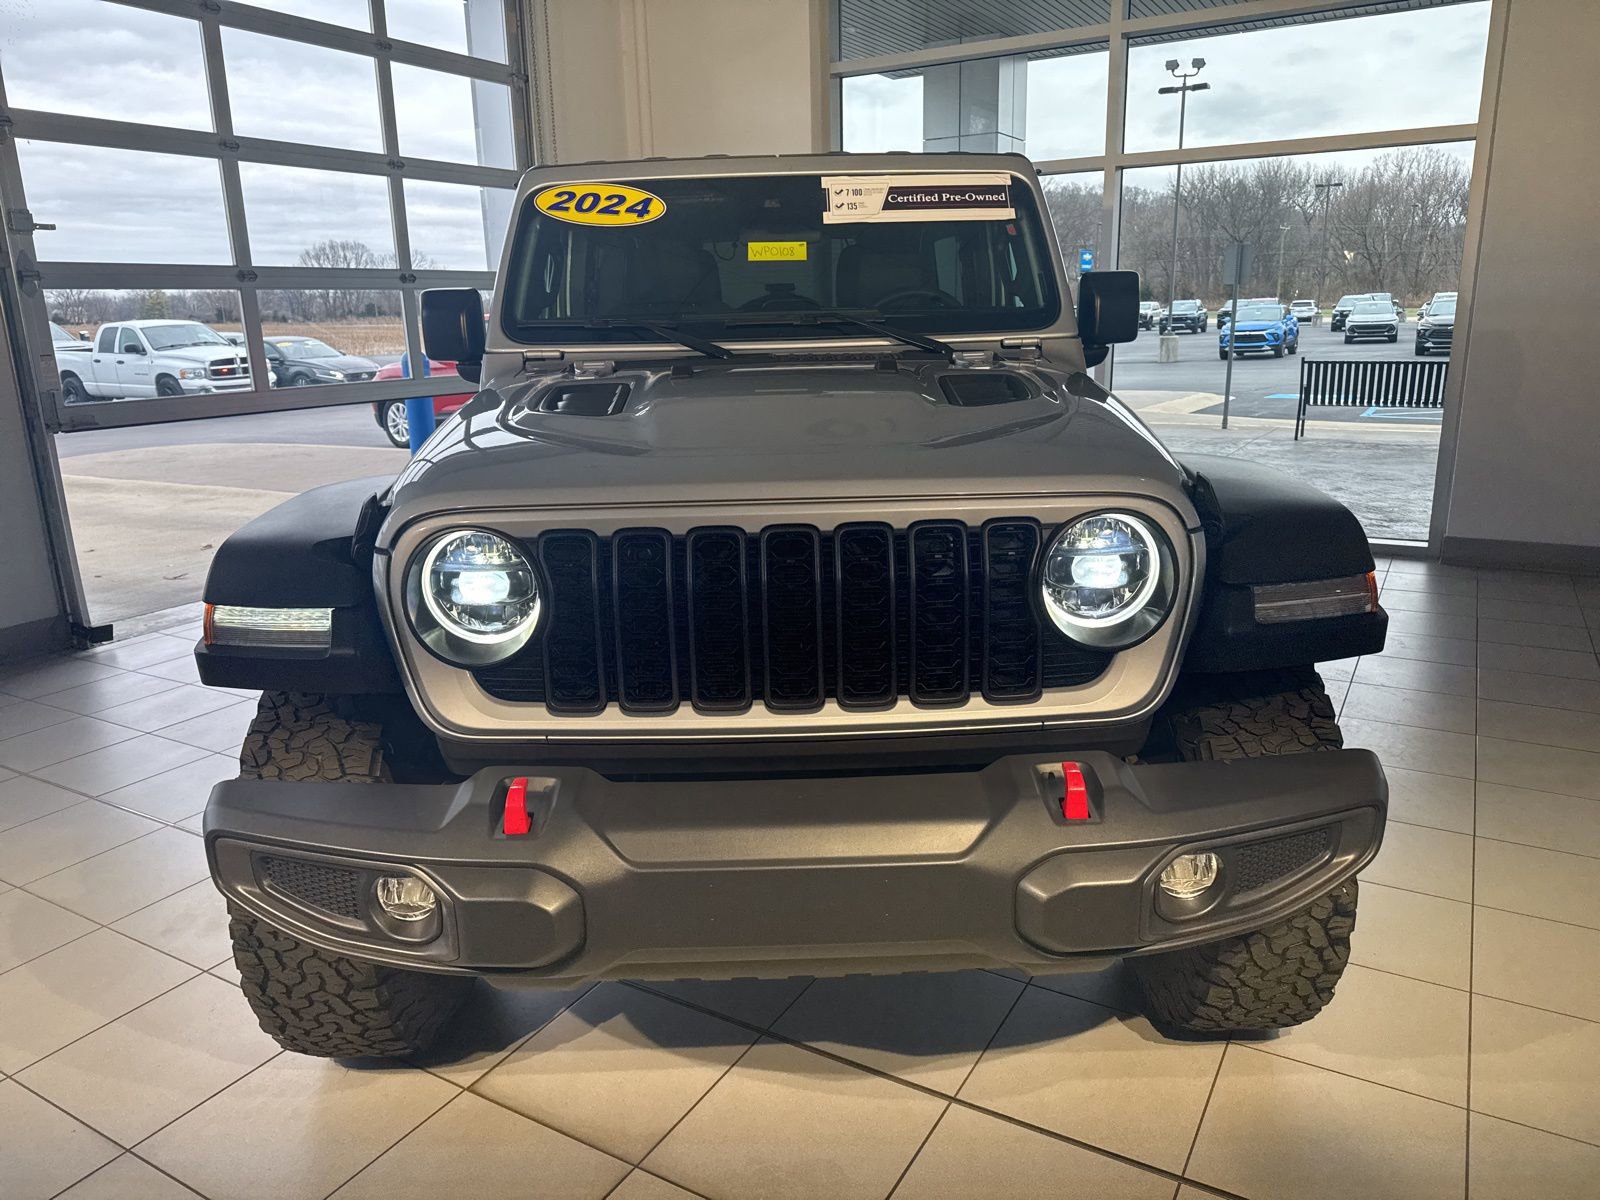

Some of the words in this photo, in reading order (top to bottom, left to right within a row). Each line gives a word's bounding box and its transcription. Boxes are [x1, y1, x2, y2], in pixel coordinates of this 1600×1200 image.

[888, 193, 938, 203] Certified
[942, 192, 1006, 202] Pre-Owned
[546, 191, 653, 218] 2024
[847, 202, 858, 210] 135
